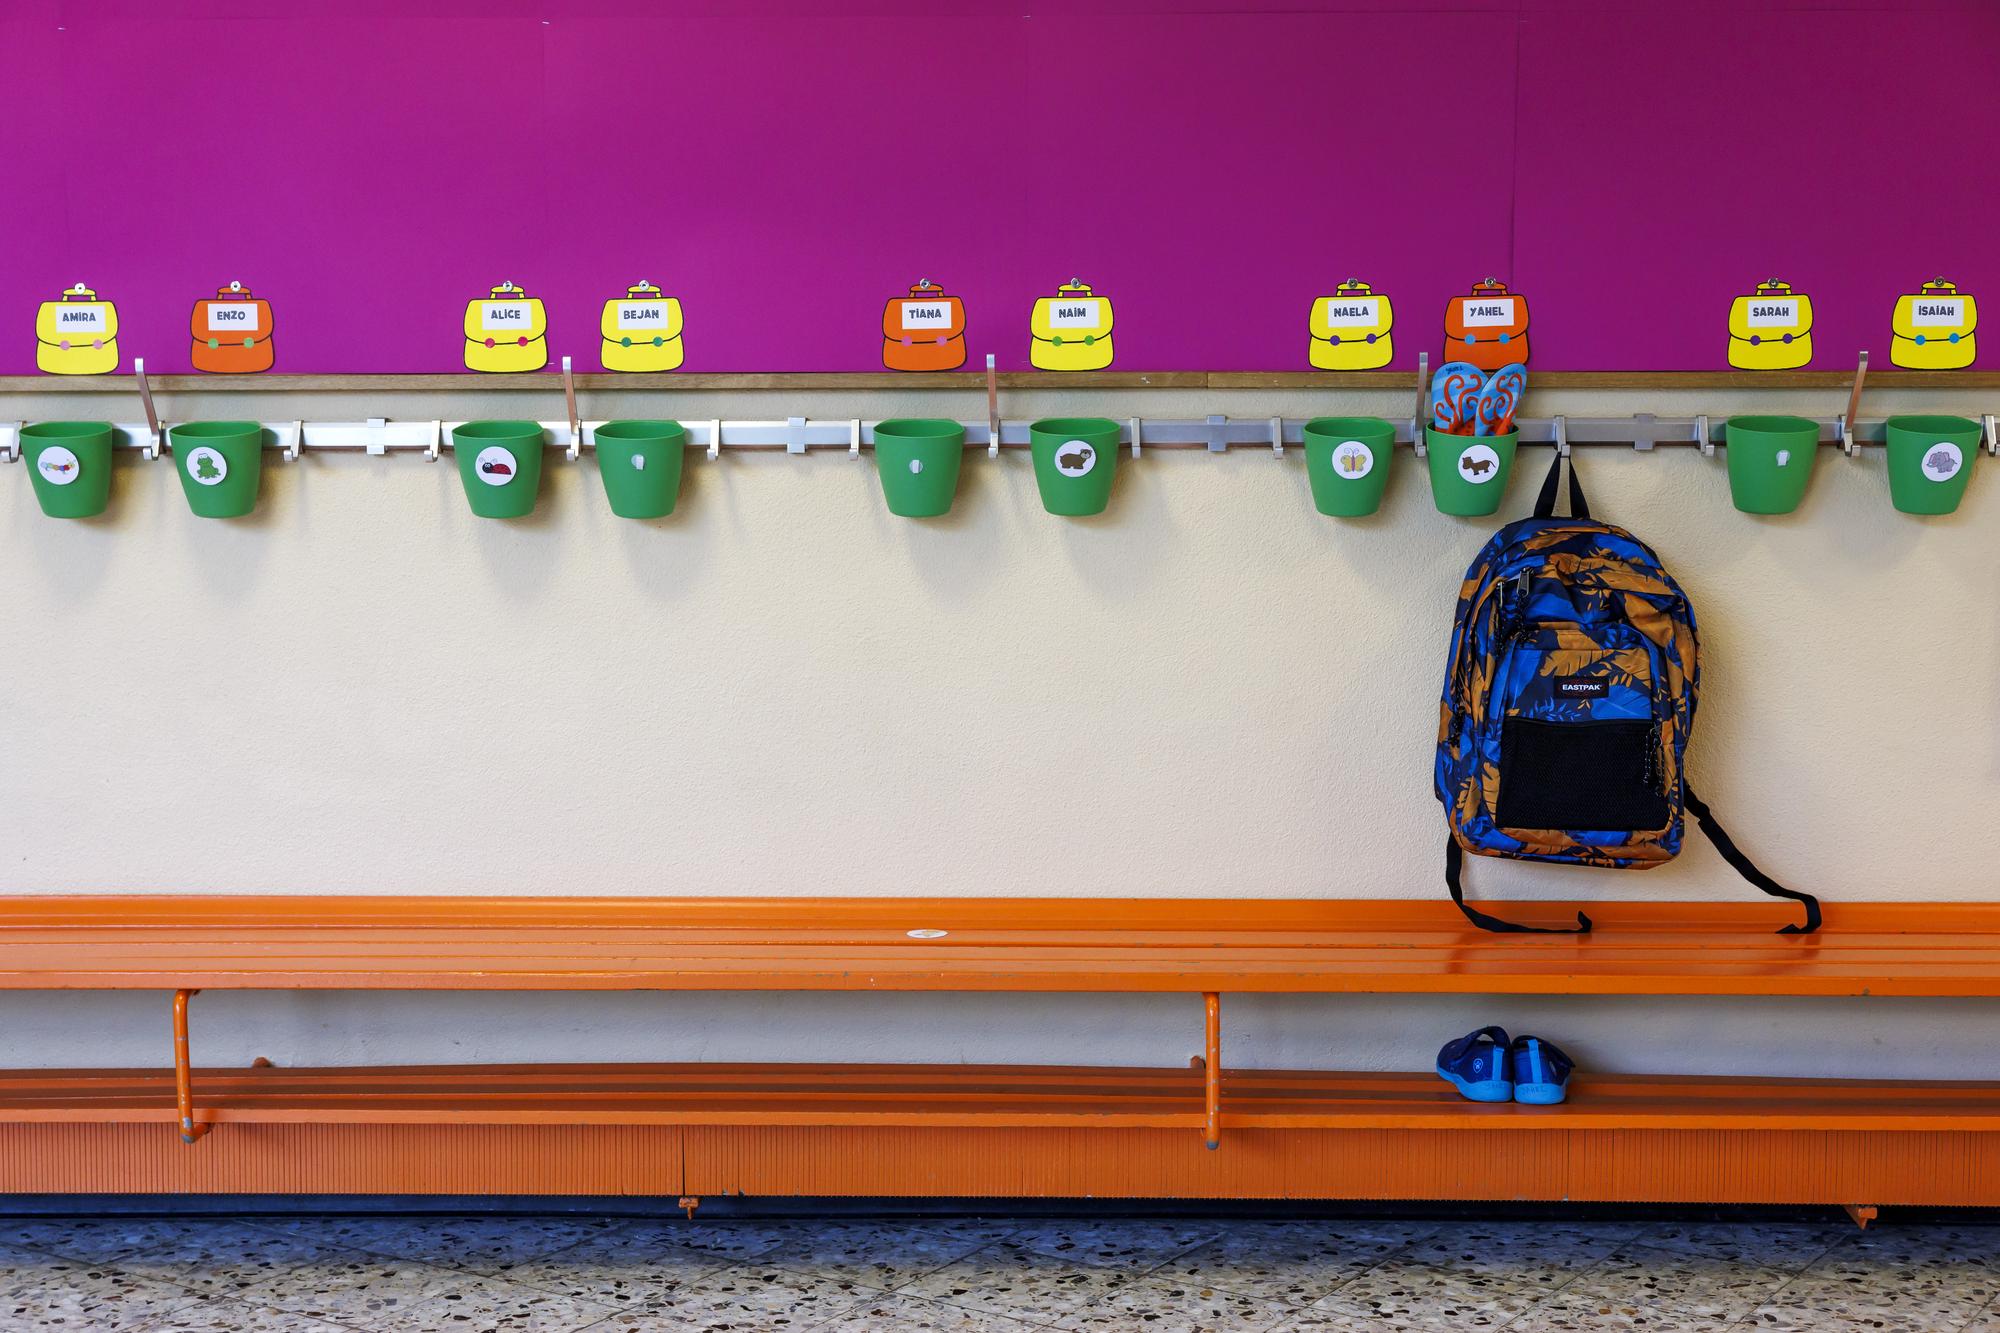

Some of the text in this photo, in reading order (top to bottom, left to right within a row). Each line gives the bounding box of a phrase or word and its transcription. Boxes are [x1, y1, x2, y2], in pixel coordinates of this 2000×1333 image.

[216, 310, 246, 320] ENZO
[623, 309, 660, 319] BEJAN
[1333, 306, 1369, 317] NAELA
[1469, 306, 1505, 316] YAHEL
[1752, 306, 1790, 317] SARAH
